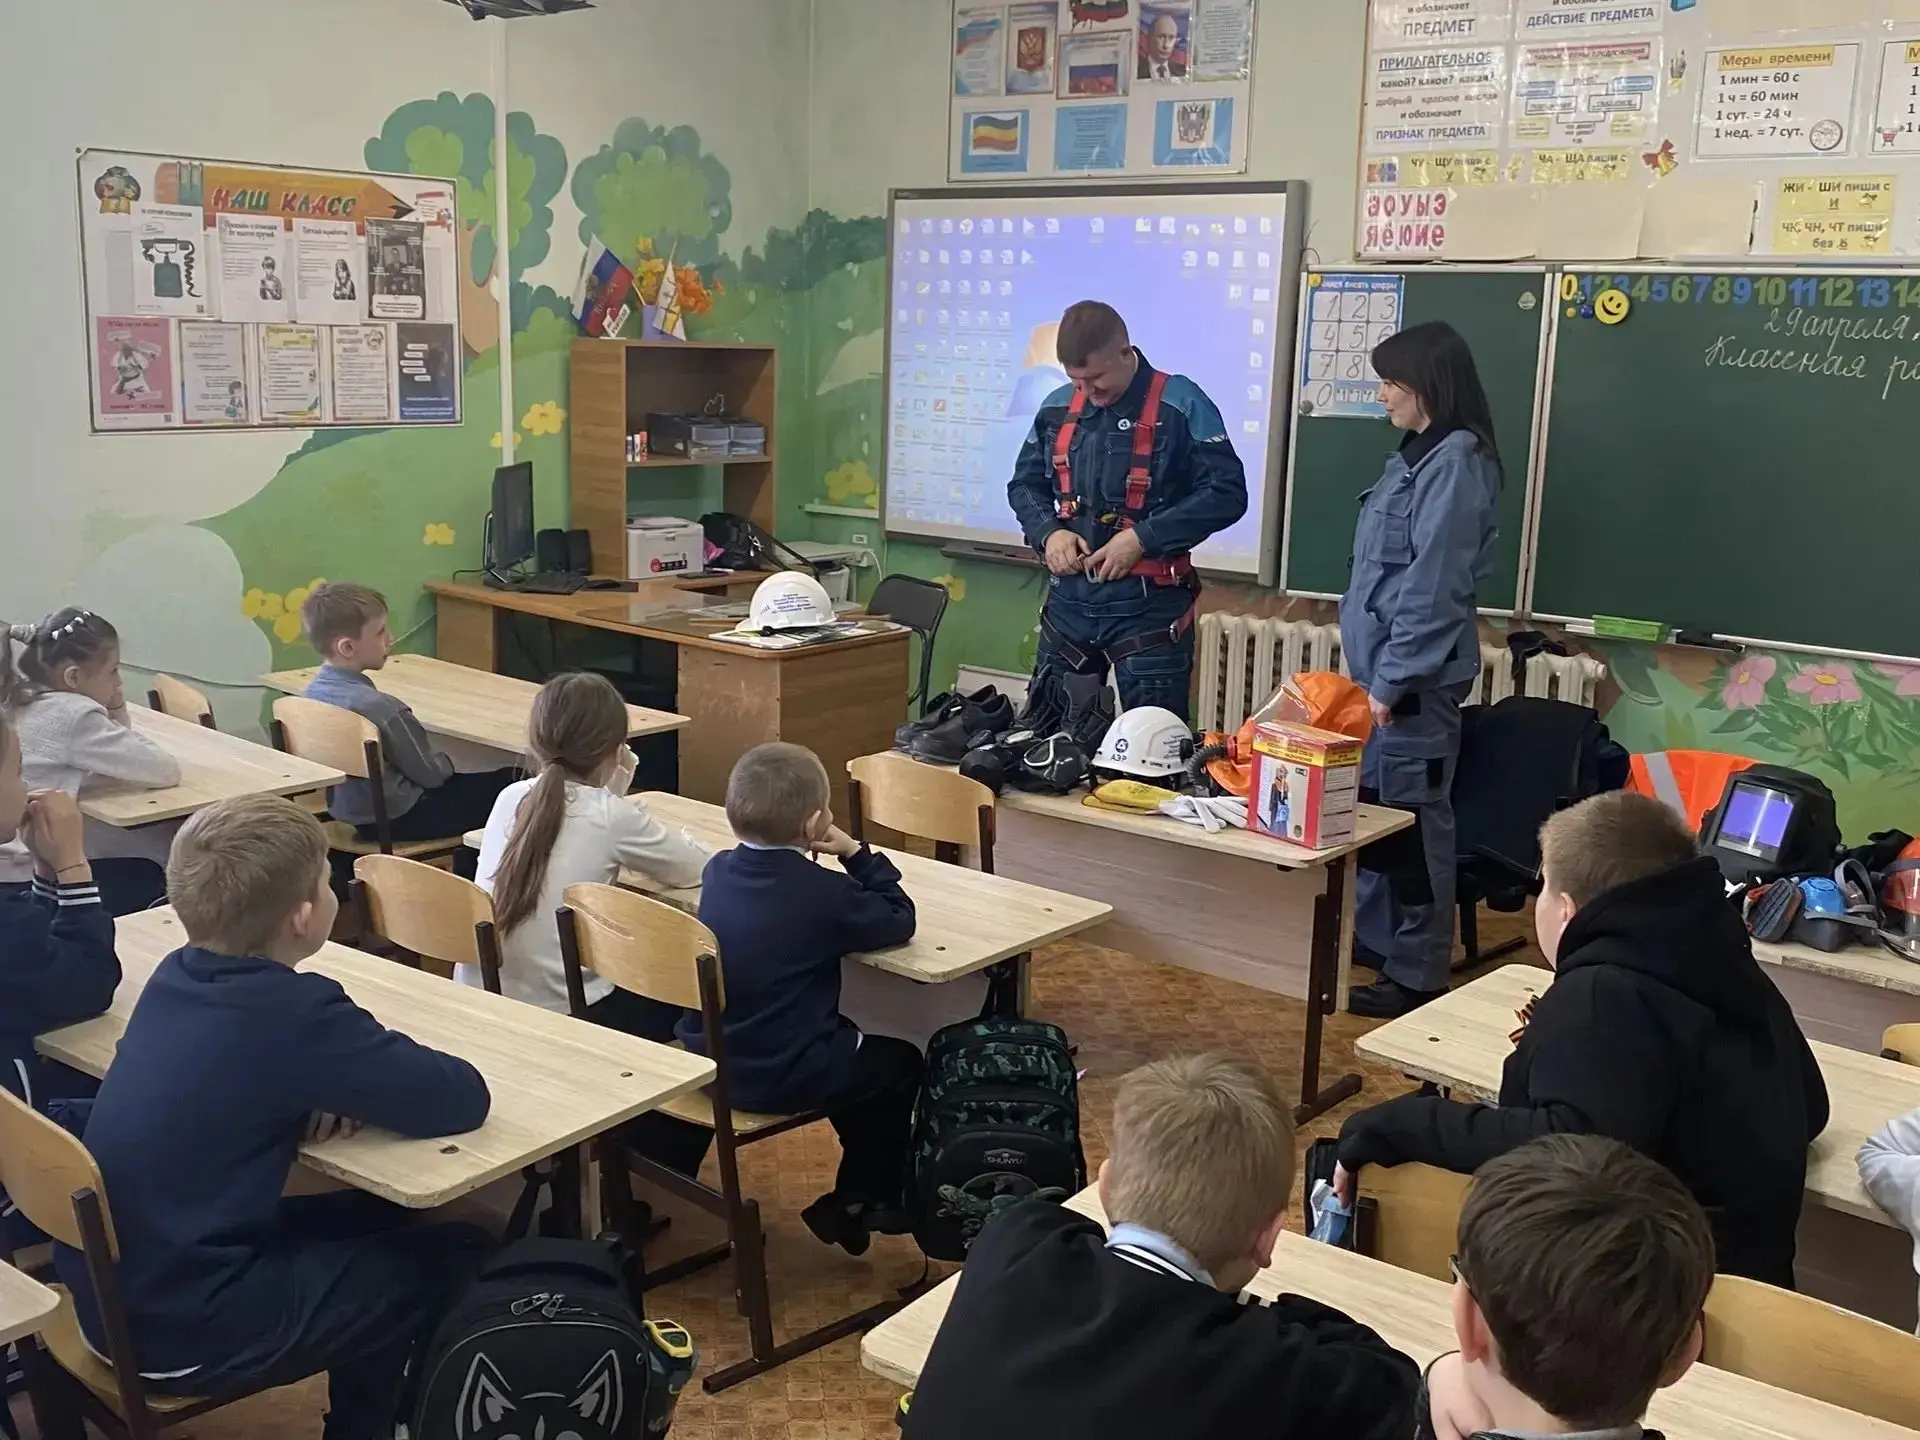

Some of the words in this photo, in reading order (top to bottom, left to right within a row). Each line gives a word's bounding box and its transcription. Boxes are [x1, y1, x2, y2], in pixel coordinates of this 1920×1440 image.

[1527, 12, 1585, 28] ДЕЙСТВИЕ
[1590, 8, 1654, 22] ПРЕДМЕТА
[1404, 19, 1476, 36] ПРЕДМЕТ
[1721, 55, 1762, 68] Меры
[1769, 52, 1831, 66] времени
[1380, 77, 1416, 88] какой?
[1720, 75, 1726, 85] 1
[1730, 75, 1758, 85] мин
[1773, 72, 1789, 82] 60
[1718, 93, 1724, 103] 1
[1750, 91, 1766, 102] 60
[1770, 92, 1798, 102] мин
[1408, 109, 1462, 118] обозначает
[1716, 110, 1722, 120] 1
[1726, 111, 1750, 122] сут.
[1764, 108, 1780, 118] 24
[1784, 110, 1791, 118] ч
[1376, 129, 1424, 140] ПРИЗНАК
[1428, 126, 1486, 138] ПРЕДМЕТА
[1714, 128, 1720, 138] 1
[1724, 130, 1752, 139] нед.
[1769, 126, 1776, 136] 7
[1780, 128, 1804, 138] сут.
[1411, 158, 1424, 166] ЧУ
[1784, 183, 1804, 192] ЖИ
[1819, 182, 1840, 192] ШИ
[1844, 184, 1880, 192] пиши
[212, 186, 270, 210] НАШ
[280, 191, 356, 216] КЛАСС
[1829, 222, 1845, 232] ЧТ
[1812, 238, 1834, 248] без
[1561, 274, 1578, 301] 0
[1579, 275, 1593, 300] 1
[1631, 275, 1650, 302] 4
[1651, 276, 1669, 302] 5
[1671, 276, 1691, 303] 6
[1692, 276, 1712, 303] 7
[1712, 276, 1731, 304] 8
[1732, 277, 1752, 305] 9
[1754, 277, 1786, 306] 10
[1788, 277, 1818, 306] 11
[1819, 278, 1854, 307] 12
[1856, 278, 1890, 308] 13
[1327, 294, 1338, 318] 1
[1352, 295, 1368, 319] 2
[1380, 295, 1396, 320] 3
[1764, 307, 1803, 337] 29
[1324, 324, 1336, 348] 4
[1349, 325, 1365, 349] 5
[1704, 336, 1867, 378] Классная
[1320, 353, 1334, 378] 7
[1346, 354, 1362, 379] 8
[1316, 382, 1332, 408] 0
